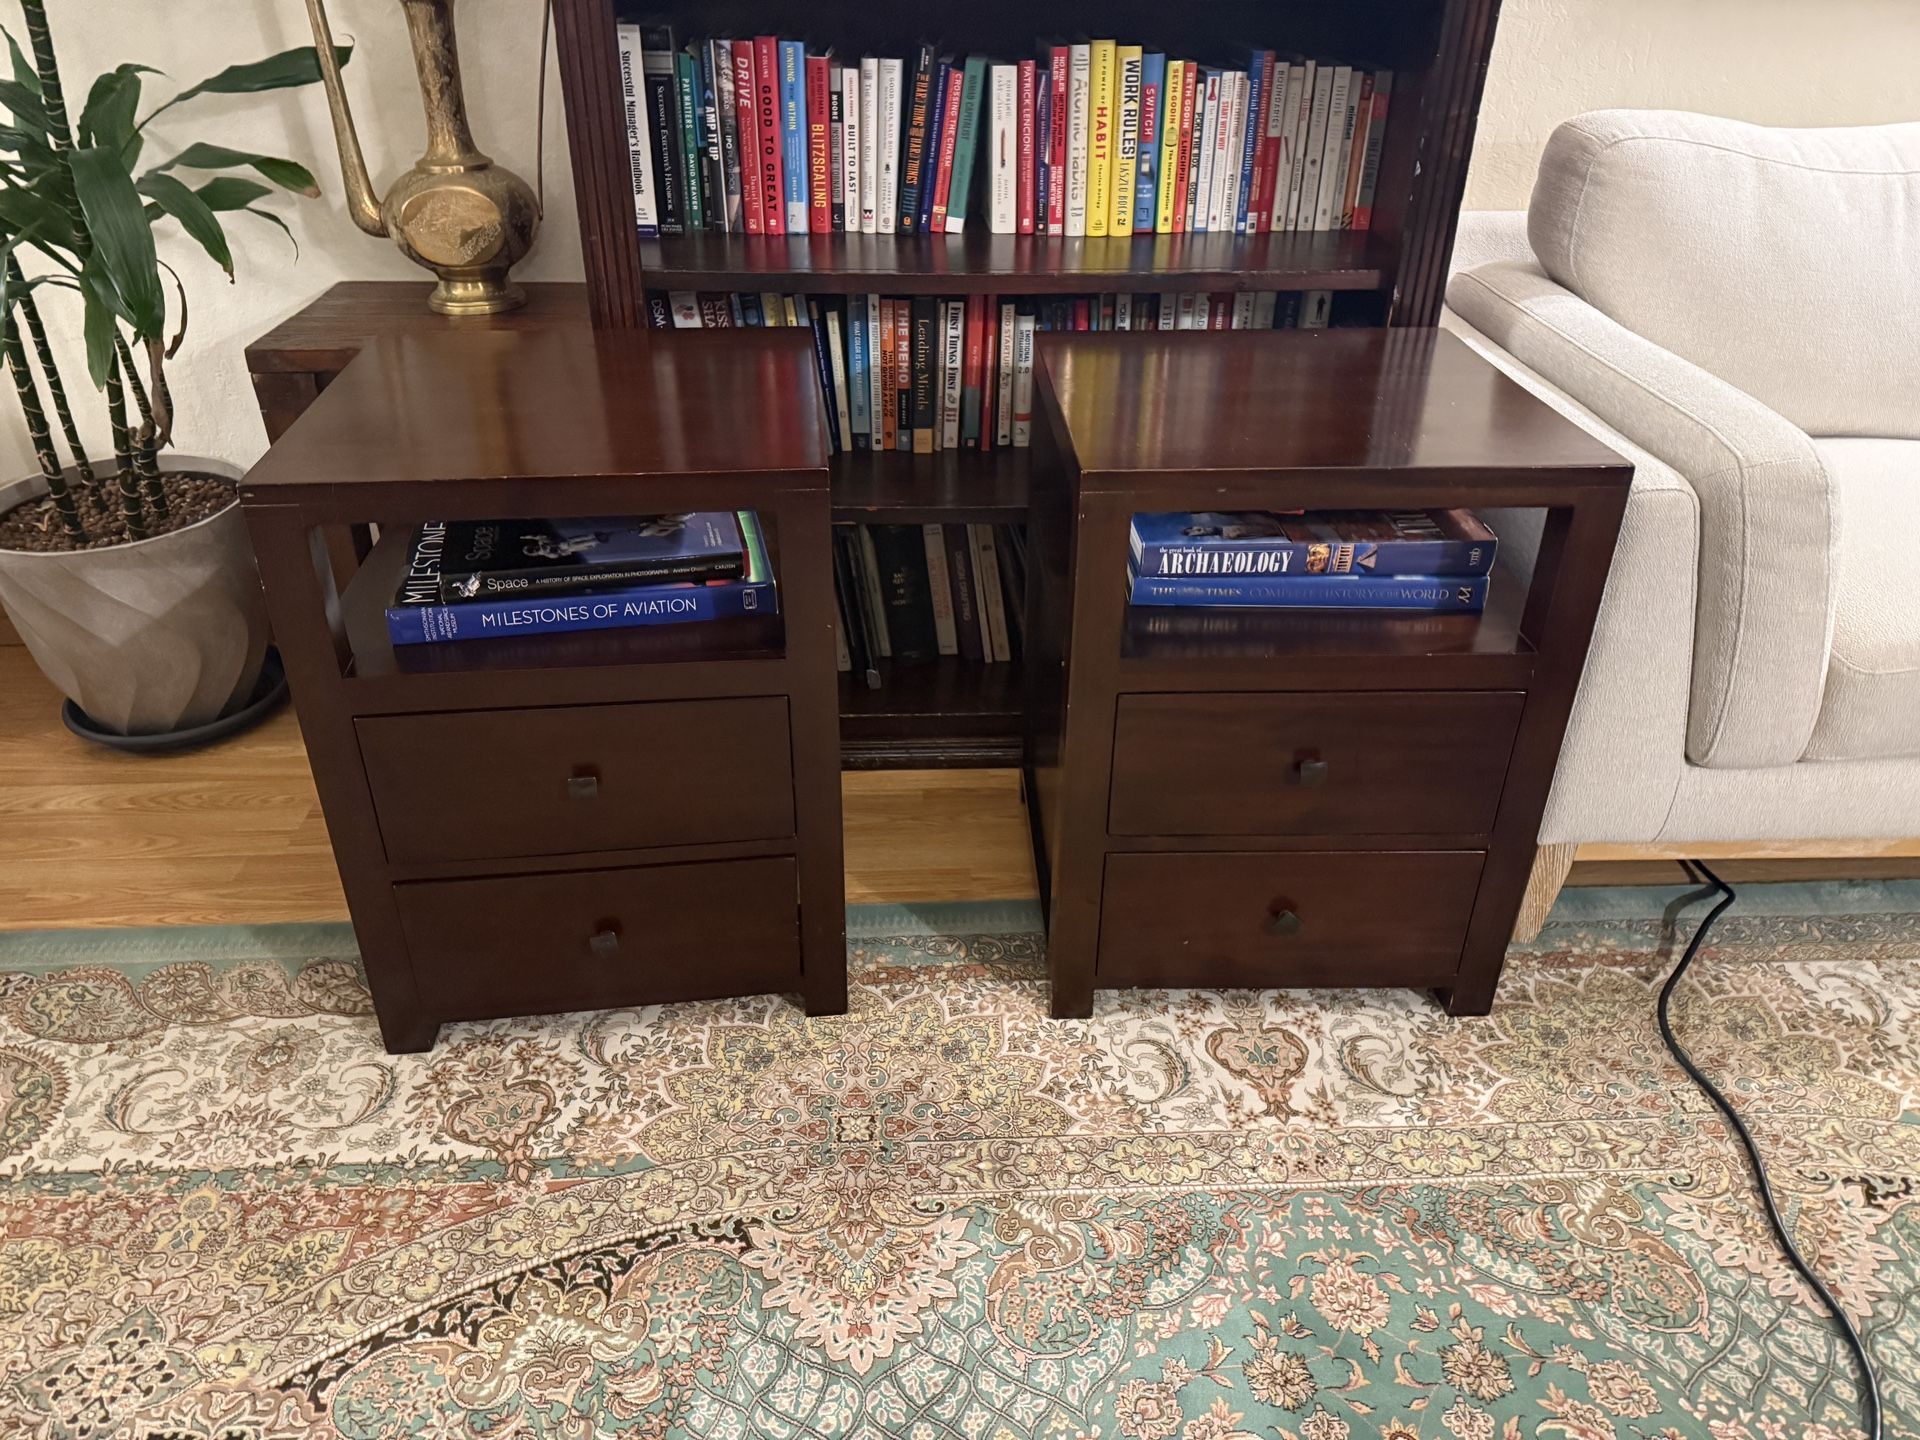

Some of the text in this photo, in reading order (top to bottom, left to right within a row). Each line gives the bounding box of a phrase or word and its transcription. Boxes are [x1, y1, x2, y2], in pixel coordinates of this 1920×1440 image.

[762, 56, 770, 78] COLLINS
[786, 47, 796, 82] WINNING
[1052, 56, 1060, 80] RULES
[1058, 56, 1065, 67] NO
[966, 74, 978, 100] NOMAD
[1168, 68, 1180, 124] SETH GODIN
[1249, 79, 1260, 111] crucial
[1272, 70, 1284, 130] BOUNDARIES
[682, 78, 693, 129] PAY MATTERS
[788, 102, 796, 130] WITHIN
[912, 104, 926, 127] THING
[1022, 66, 1031, 154] PATRICK LENCIONI
[1122, 60, 1140, 161] WORK RULES!
[1144, 88, 1155, 137] SWITCH
[1220, 101, 1230, 120] START
[622, 51, 644, 195] Successful Manager's Handbook
[706, 106, 718, 161] AMP IT UP
[944, 73, 962, 168] CROSSING THE CHASM
[961, 102, 974, 141] CAPITALIST
[1095, 106, 1107, 160] HABIT
[1178, 72, 1194, 183] SETH GODIN LINCHPIN
[1194, 112, 1202, 133] POKE
[1218, 121, 1228, 136] WITH
[1344, 106, 1356, 141] mindset
[762, 86, 777, 212] GOOD TO GREAT
[848, 124, 856, 152] BUILT
[1218, 137, 1228, 151] WHY
[1242, 113, 1257, 176] accountability
[811, 124, 827, 208] BLITZSCALING
[832, 127, 840, 199] INSIDE THE TORNADO
[848, 155, 856, 168] TO
[906, 160, 919, 185] THINGS
[1191, 152, 1200, 168] BOX
[688, 154, 698, 210] DAVID WEAVER
[750, 176, 758, 200] Daniel
[848, 171, 856, 194] LAST
[1118, 162, 1129, 193] LASZLO
[1164, 182, 1172, 211] Deception
[1224, 192, 1234, 218] HARRELL
[949, 306, 962, 332] FIRST
[854, 336, 862, 354] COLOR
[898, 308, 910, 384] THE MEMO
[948, 334, 960, 365] THINGS
[1002, 328, 1011, 368] STARTUP
[914, 320, 930, 410] Leading Minds
[946, 366, 959, 391] FIRST
[1158, 552, 1293, 574] ARCHAEOLOGY
[487, 578, 528, 592] Space
[630, 568, 668, 577] PHOTOGRAPHS
[1152, 586, 1176, 594] THE
[1208, 588, 1242, 596] TIMES
[1400, 588, 1450, 600] WORLD
[420, 606, 432, 642] SMITHSONIAN
[428, 607, 437, 640] INSTITUTION
[482, 598, 697, 628] MILESTONES OF AVIATION
